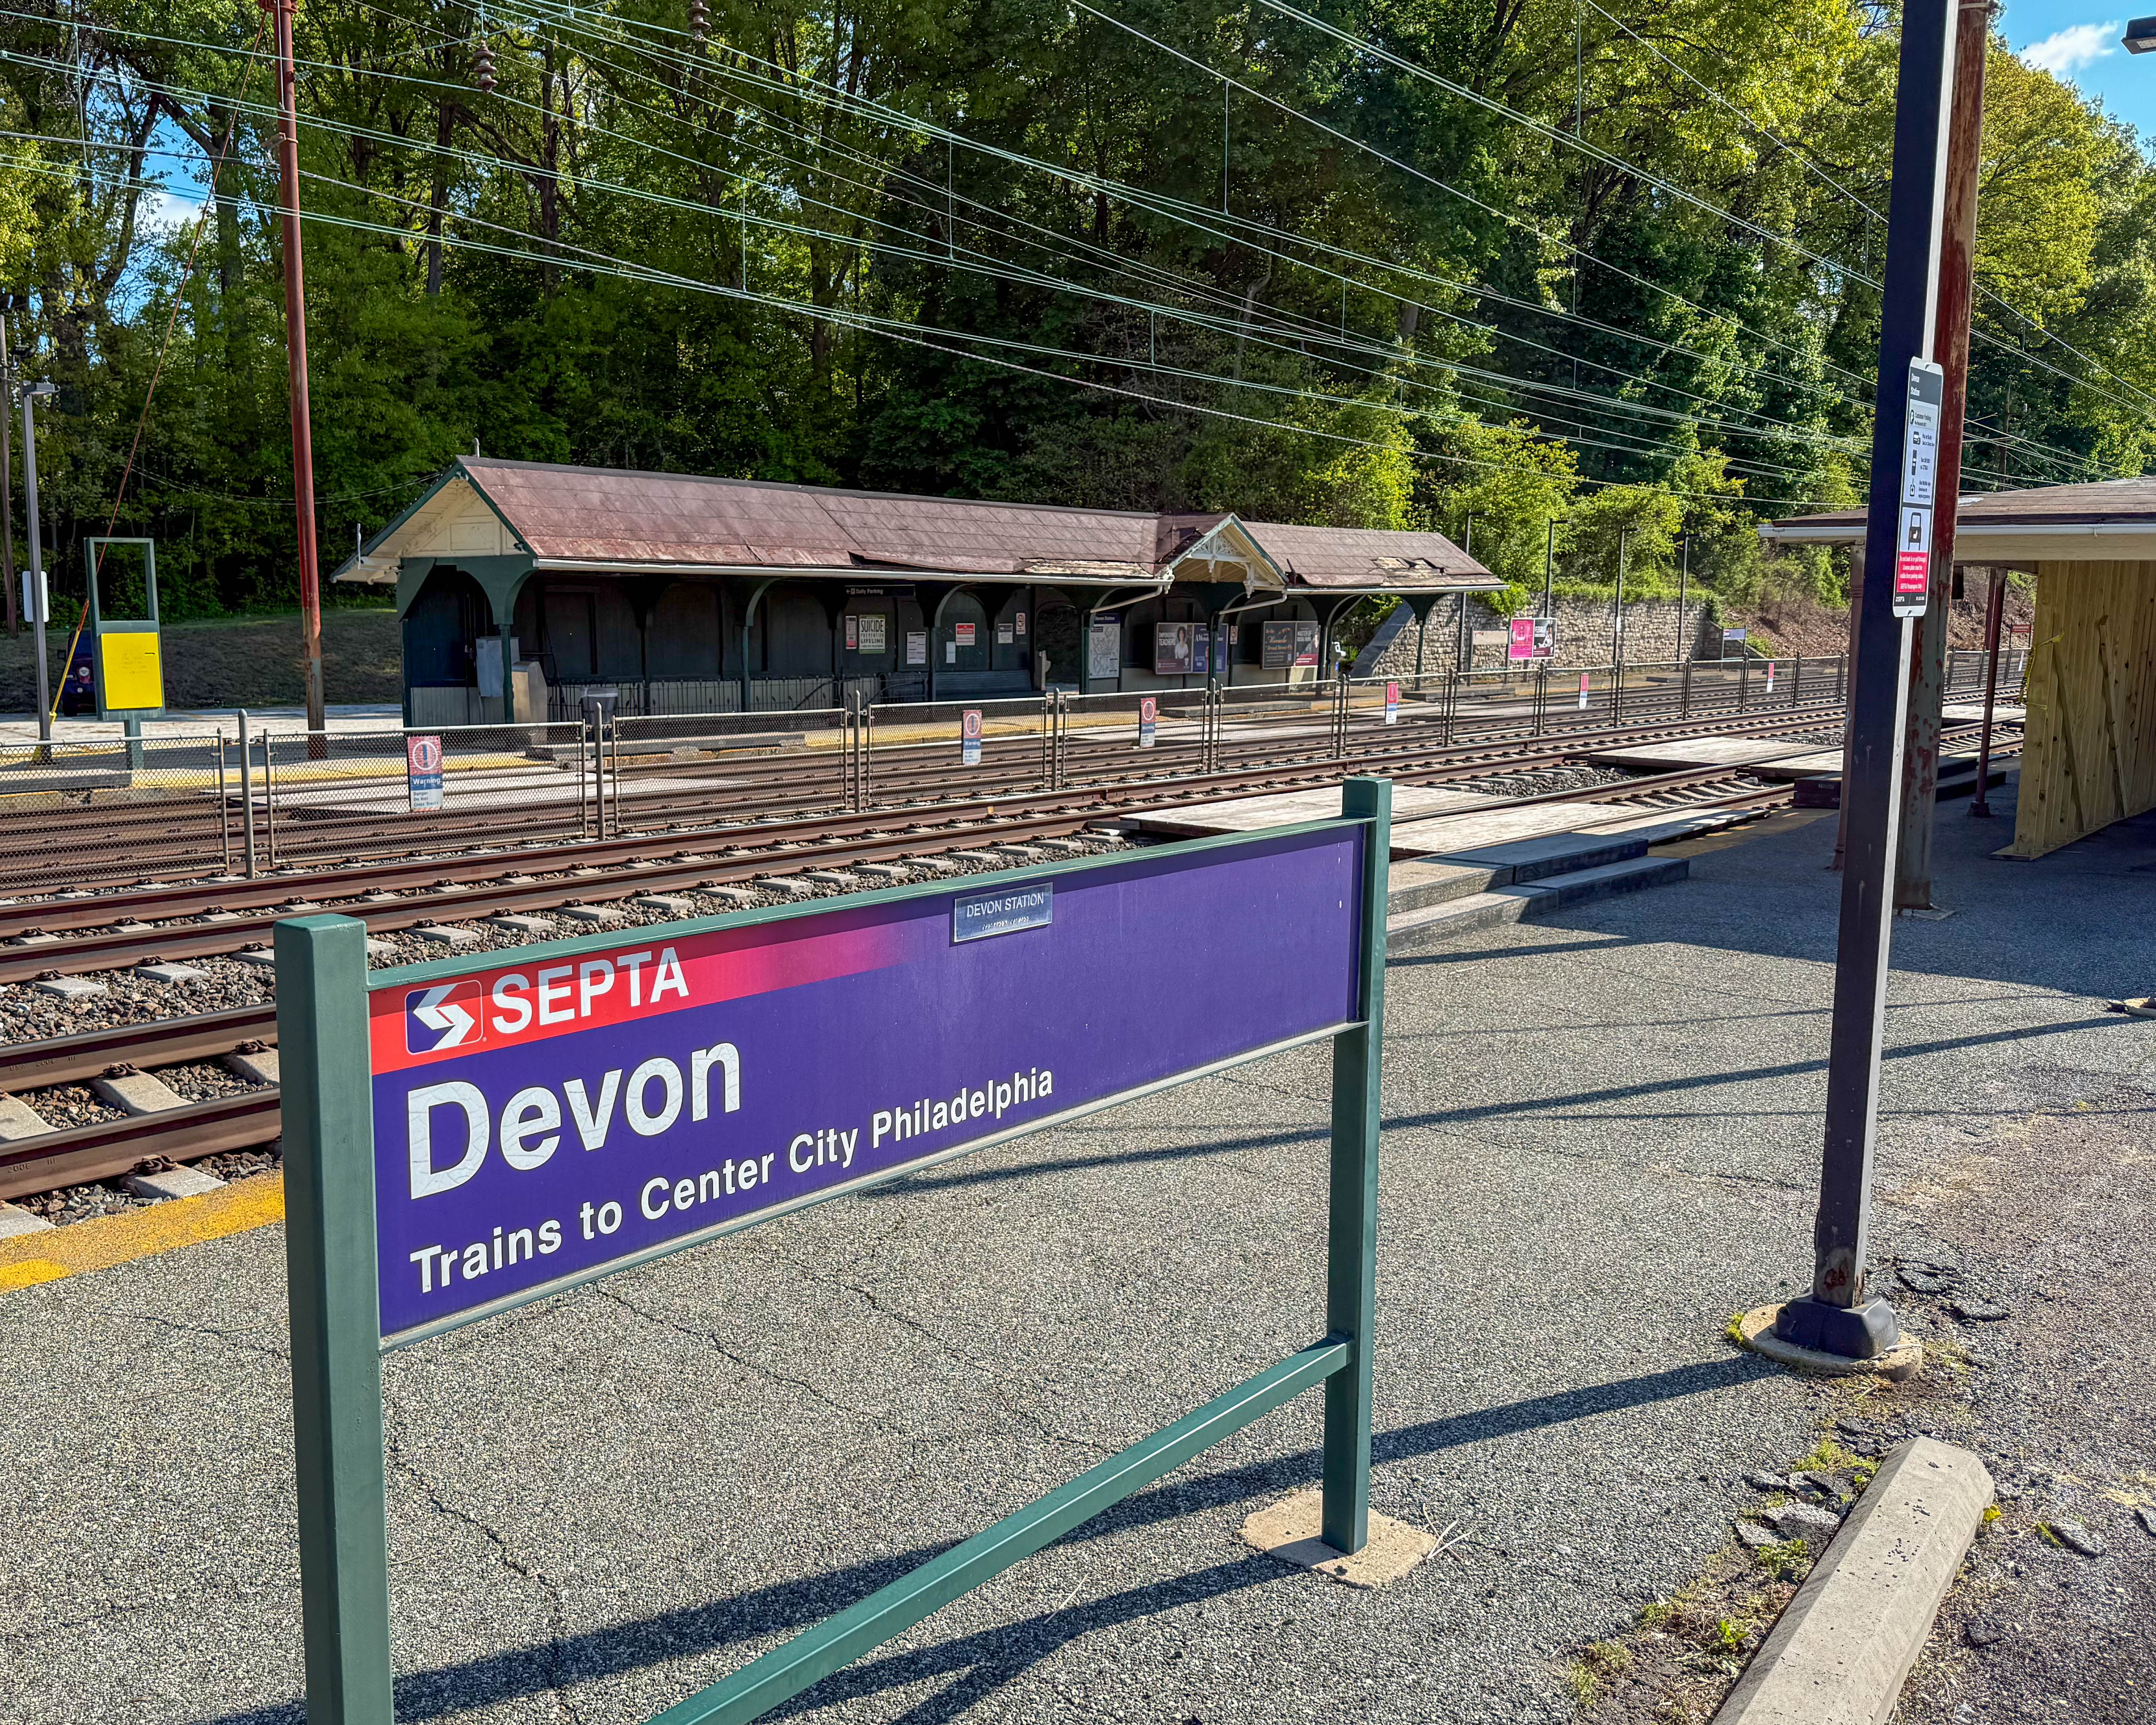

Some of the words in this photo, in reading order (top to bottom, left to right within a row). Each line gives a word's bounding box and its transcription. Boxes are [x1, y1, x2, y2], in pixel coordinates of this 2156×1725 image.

[861, 620, 884, 632] SUICIDE
[967, 899, 1002, 918] DEVON
[1005, 891, 1044, 911] STATION
[492, 947, 689, 1034] SEPTA
[408, 1042, 740, 1200] Devon
[410, 1219, 562, 1293] Trains
[580, 1201, 622, 1240] to
[641, 1152, 775, 1220] Center
[789, 1128, 858, 1173] City
[873, 1067, 1053, 1149] Philadelphia
